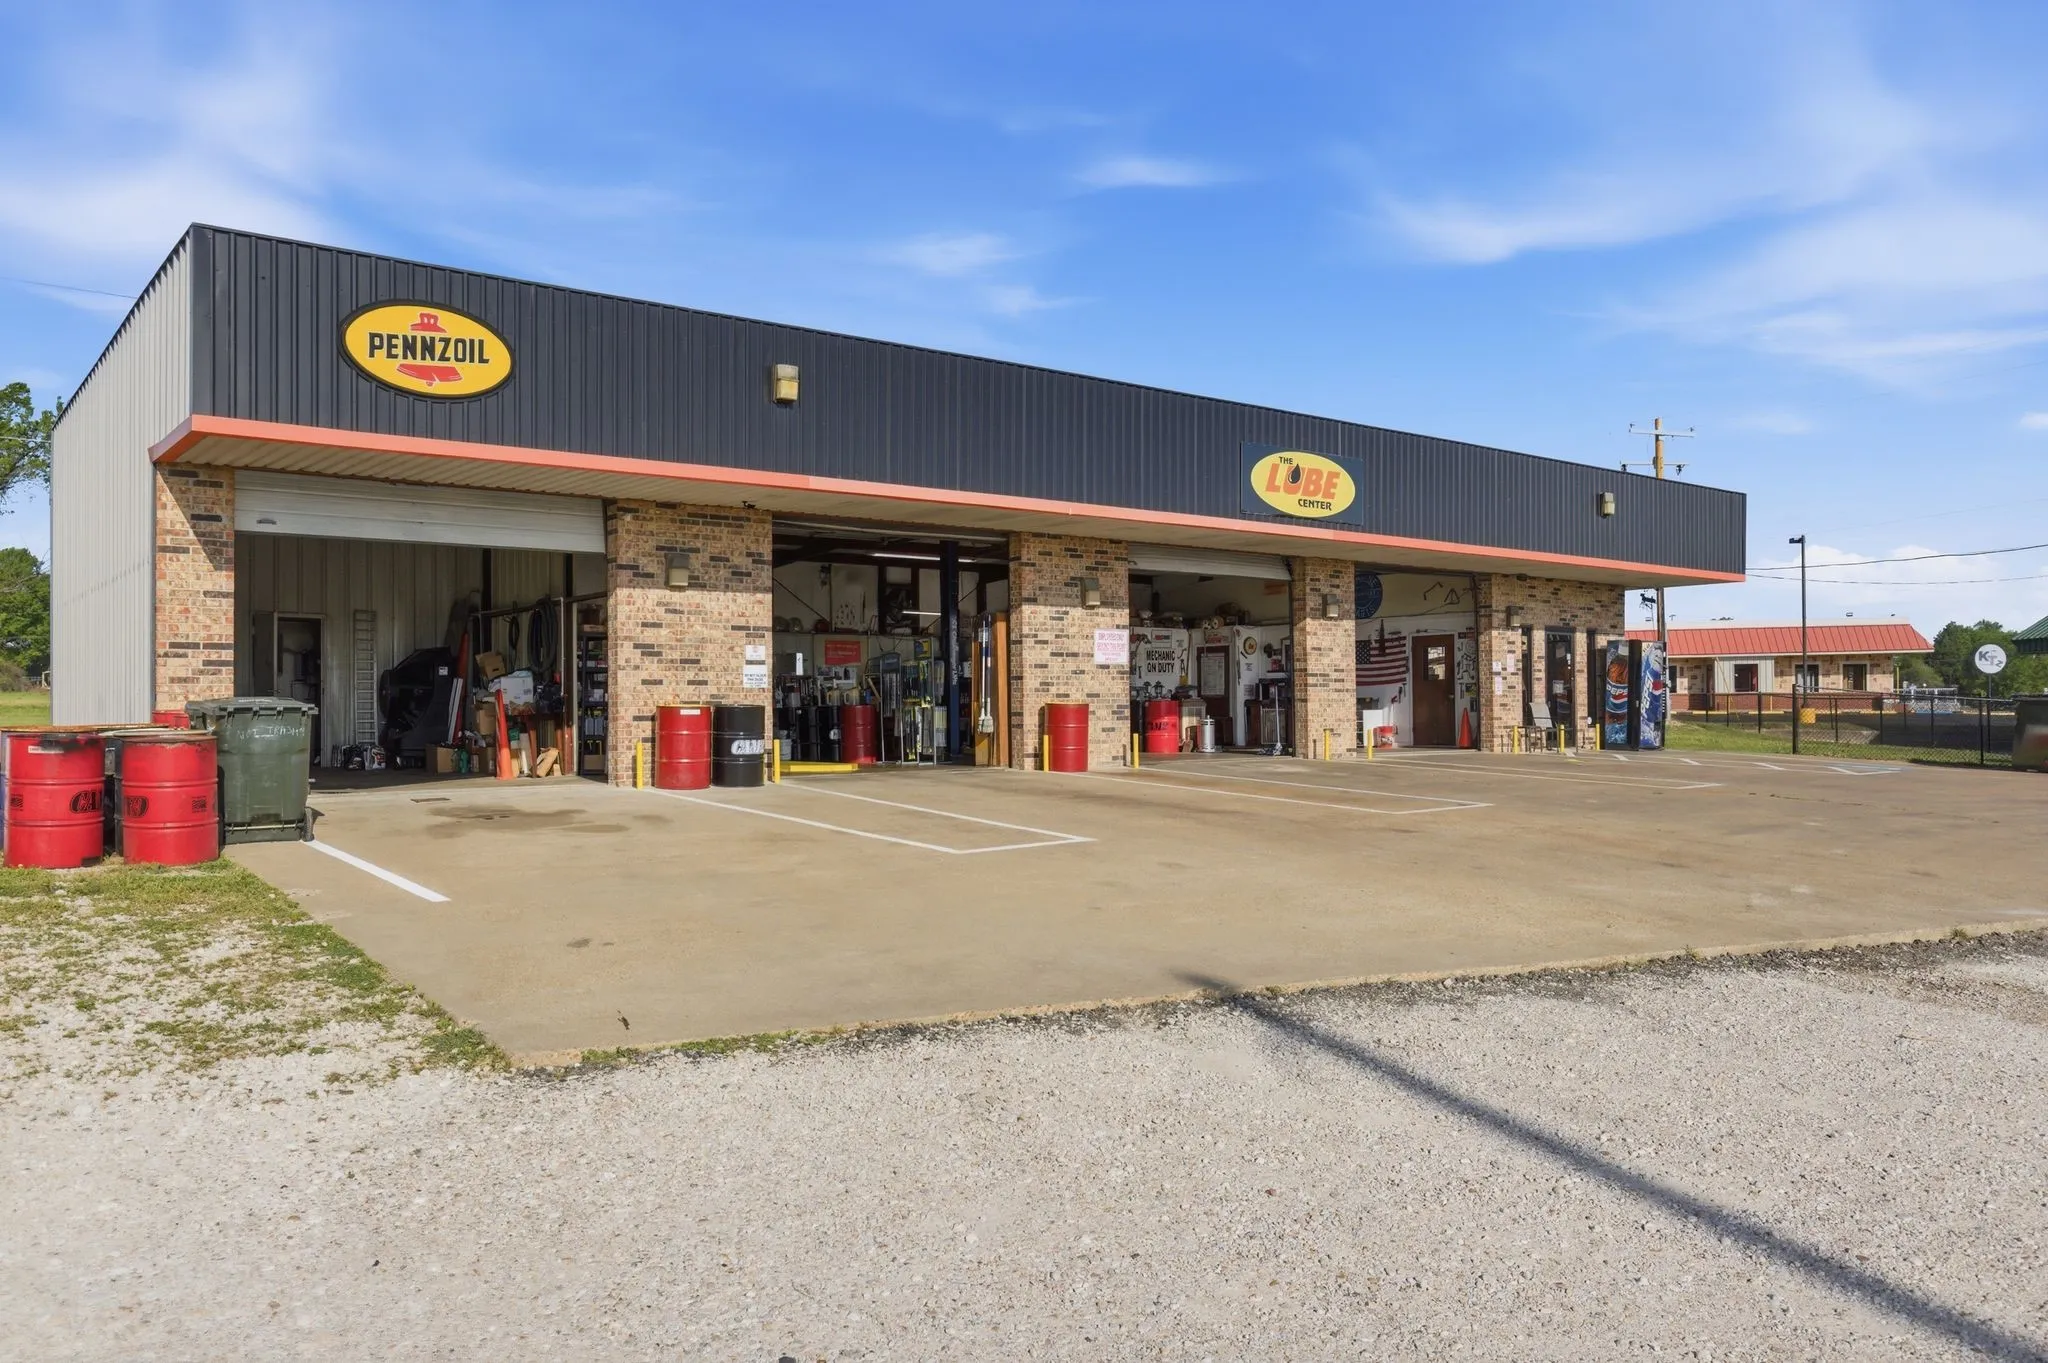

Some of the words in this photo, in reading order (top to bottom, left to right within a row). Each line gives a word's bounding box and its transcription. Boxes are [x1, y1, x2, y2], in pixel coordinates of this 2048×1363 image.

[368, 332, 490, 364] PENNZOIL
[1279, 456, 1293, 465] THE
[1265, 463, 1341, 500] LUBE
[1298, 499, 1332, 511] CENTER
[1146, 650, 1176, 661] MECHANIC
[1147, 662, 1157, 673] ON
[1158, 662, 1175, 673] DUTY
